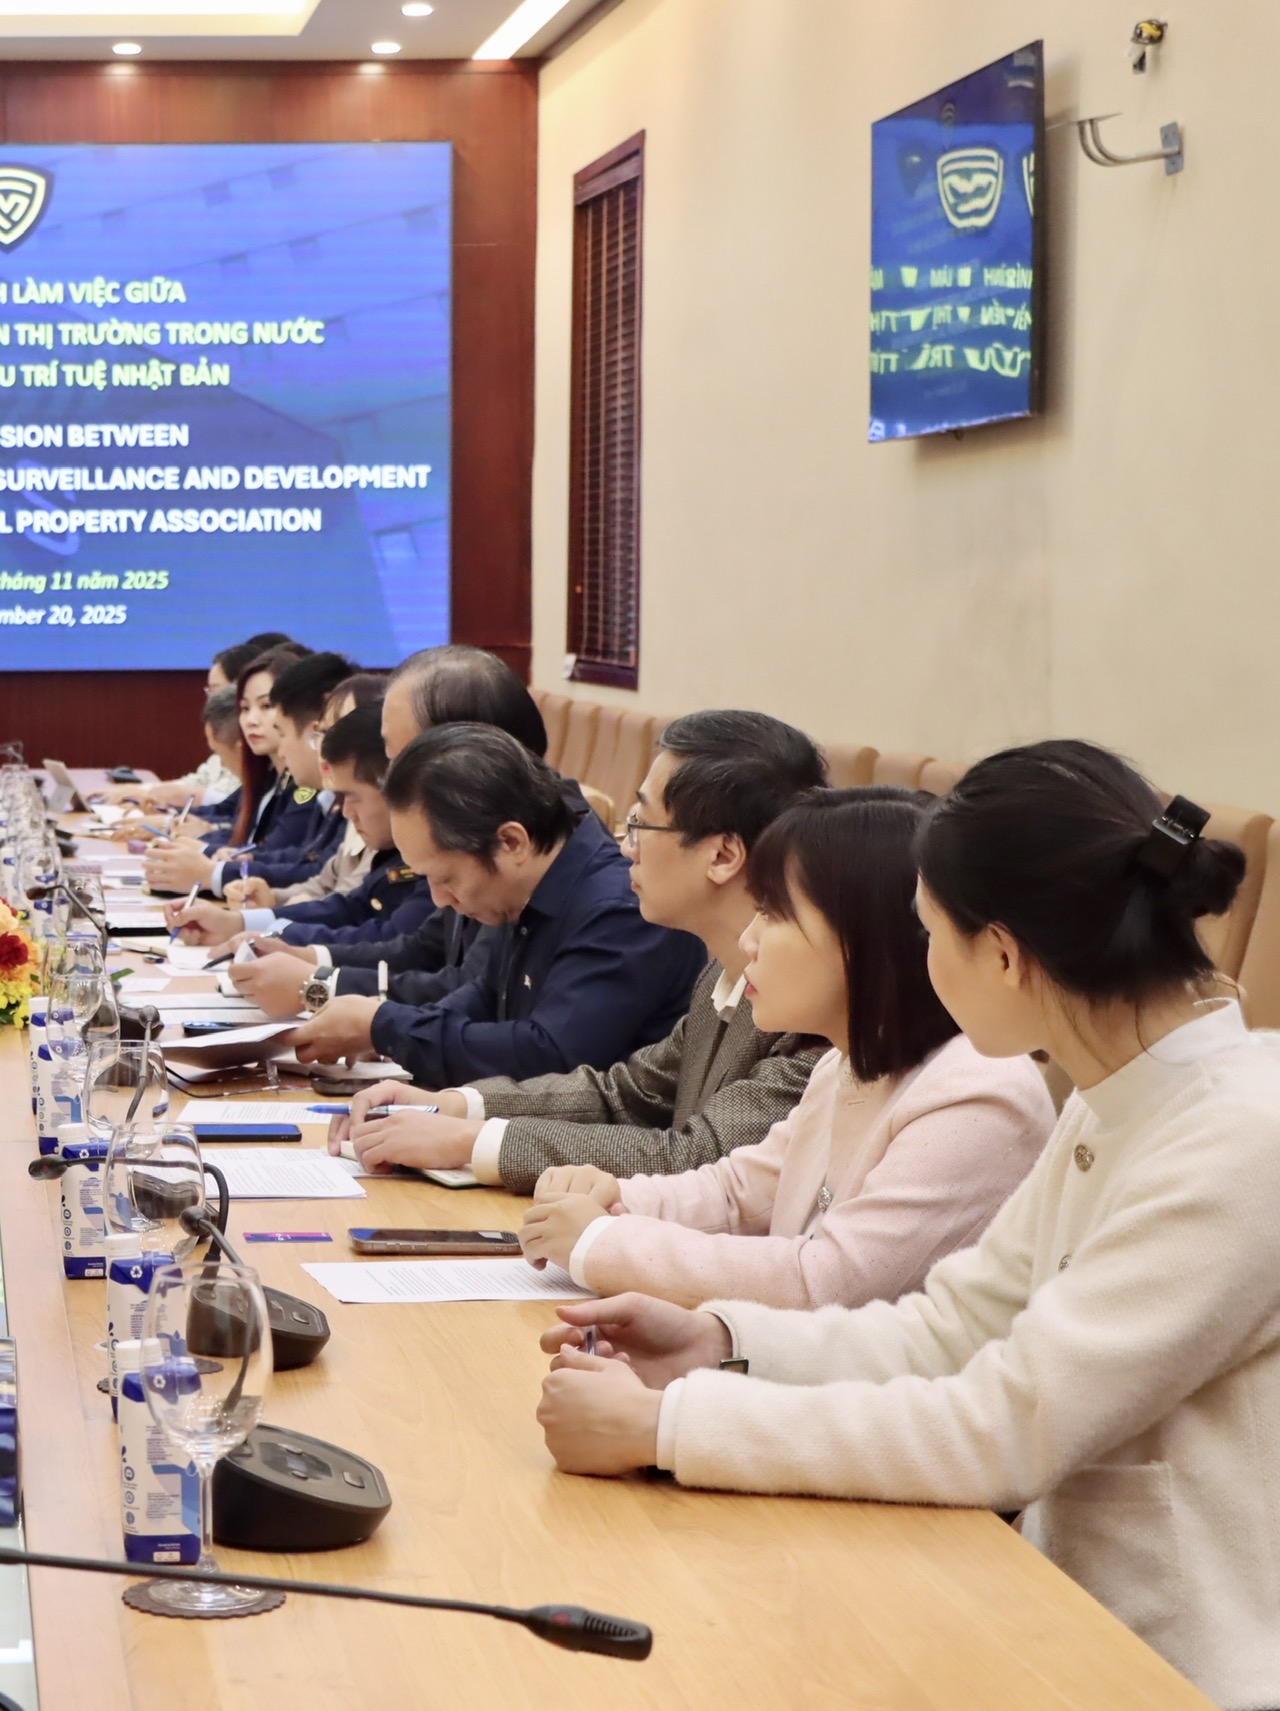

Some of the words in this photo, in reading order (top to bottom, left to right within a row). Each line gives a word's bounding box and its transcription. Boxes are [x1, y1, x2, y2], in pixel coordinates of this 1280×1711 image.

[12, 276, 64, 304] LÀM
[67, 275, 121, 308] VIỆC
[124, 275, 187, 304] GIỮA
[13, 322, 54, 350] THỊ
[57, 317, 162, 346] TRƯỜNG
[164, 320, 249, 345] TRONG
[252, 315, 325, 345] NƯỚC
[19, 359, 59, 387] TRÍ
[60, 359, 108, 391] TUỆ
[111, 358, 177, 391] NHẬT
[179, 356, 230, 386] BẢN
[67, 423, 189, 448] BETWEEN
[183, 466, 241, 490] AND
[244, 464, 432, 490] DEVELOPMENT
[16, 509, 148, 534] PROPERTY
[149, 508, 322, 533] ASSOCIATION
[50, 571, 73, 590] 11
[76, 570, 119, 590] năm
[121, 570, 169, 590] 2025
[47, 605, 76, 627] 20,
[80, 604, 127, 625] 2025
